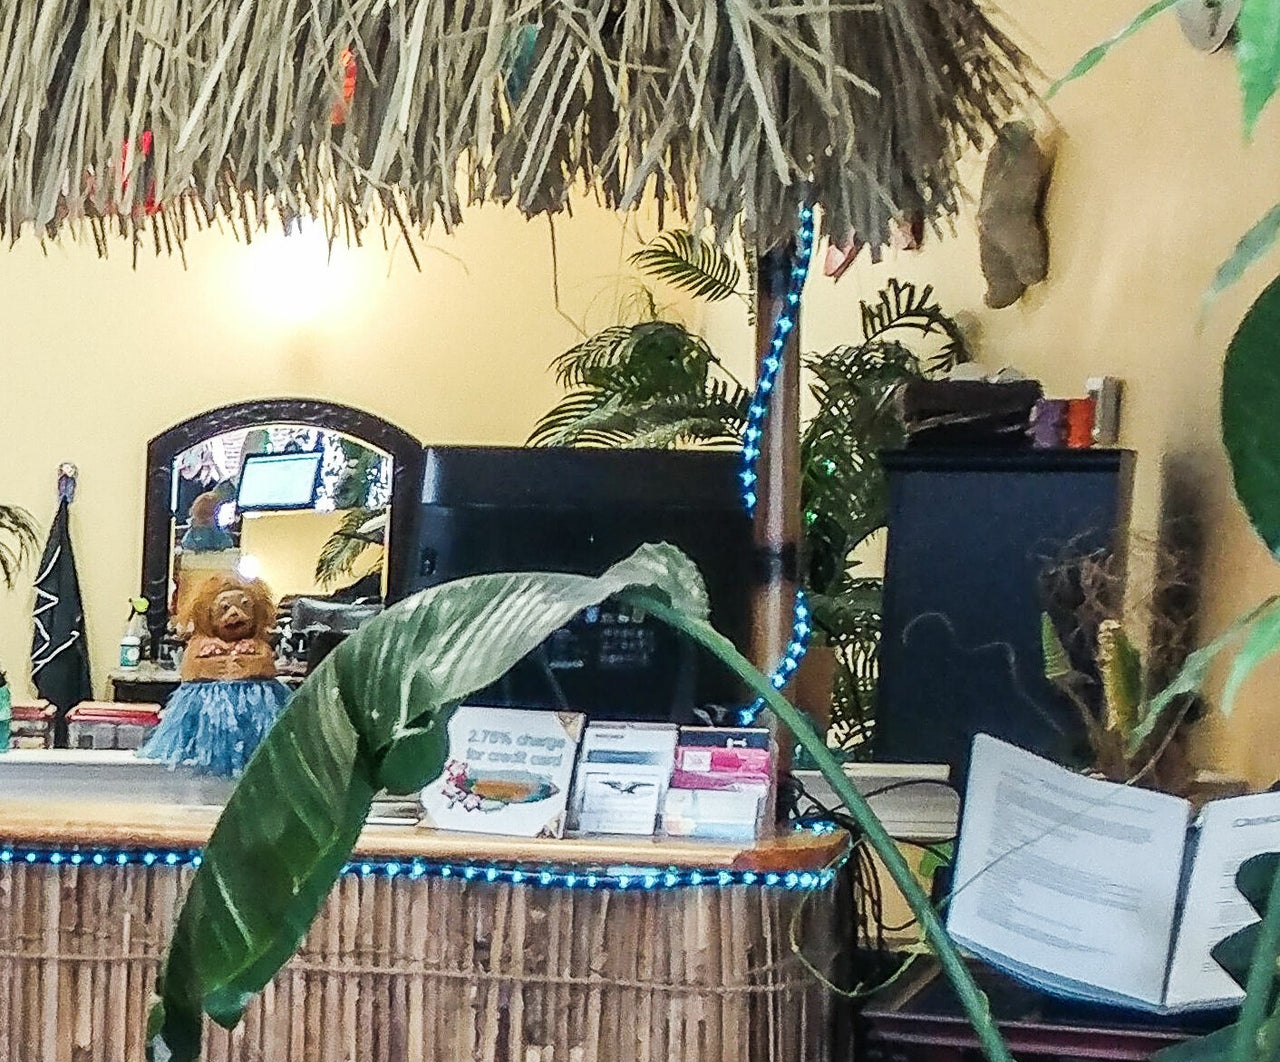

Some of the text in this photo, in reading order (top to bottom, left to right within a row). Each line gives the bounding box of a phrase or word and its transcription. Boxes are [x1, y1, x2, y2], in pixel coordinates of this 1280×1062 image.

[516, 734, 566, 751] charge
[466, 748, 562, 766] for credit card
